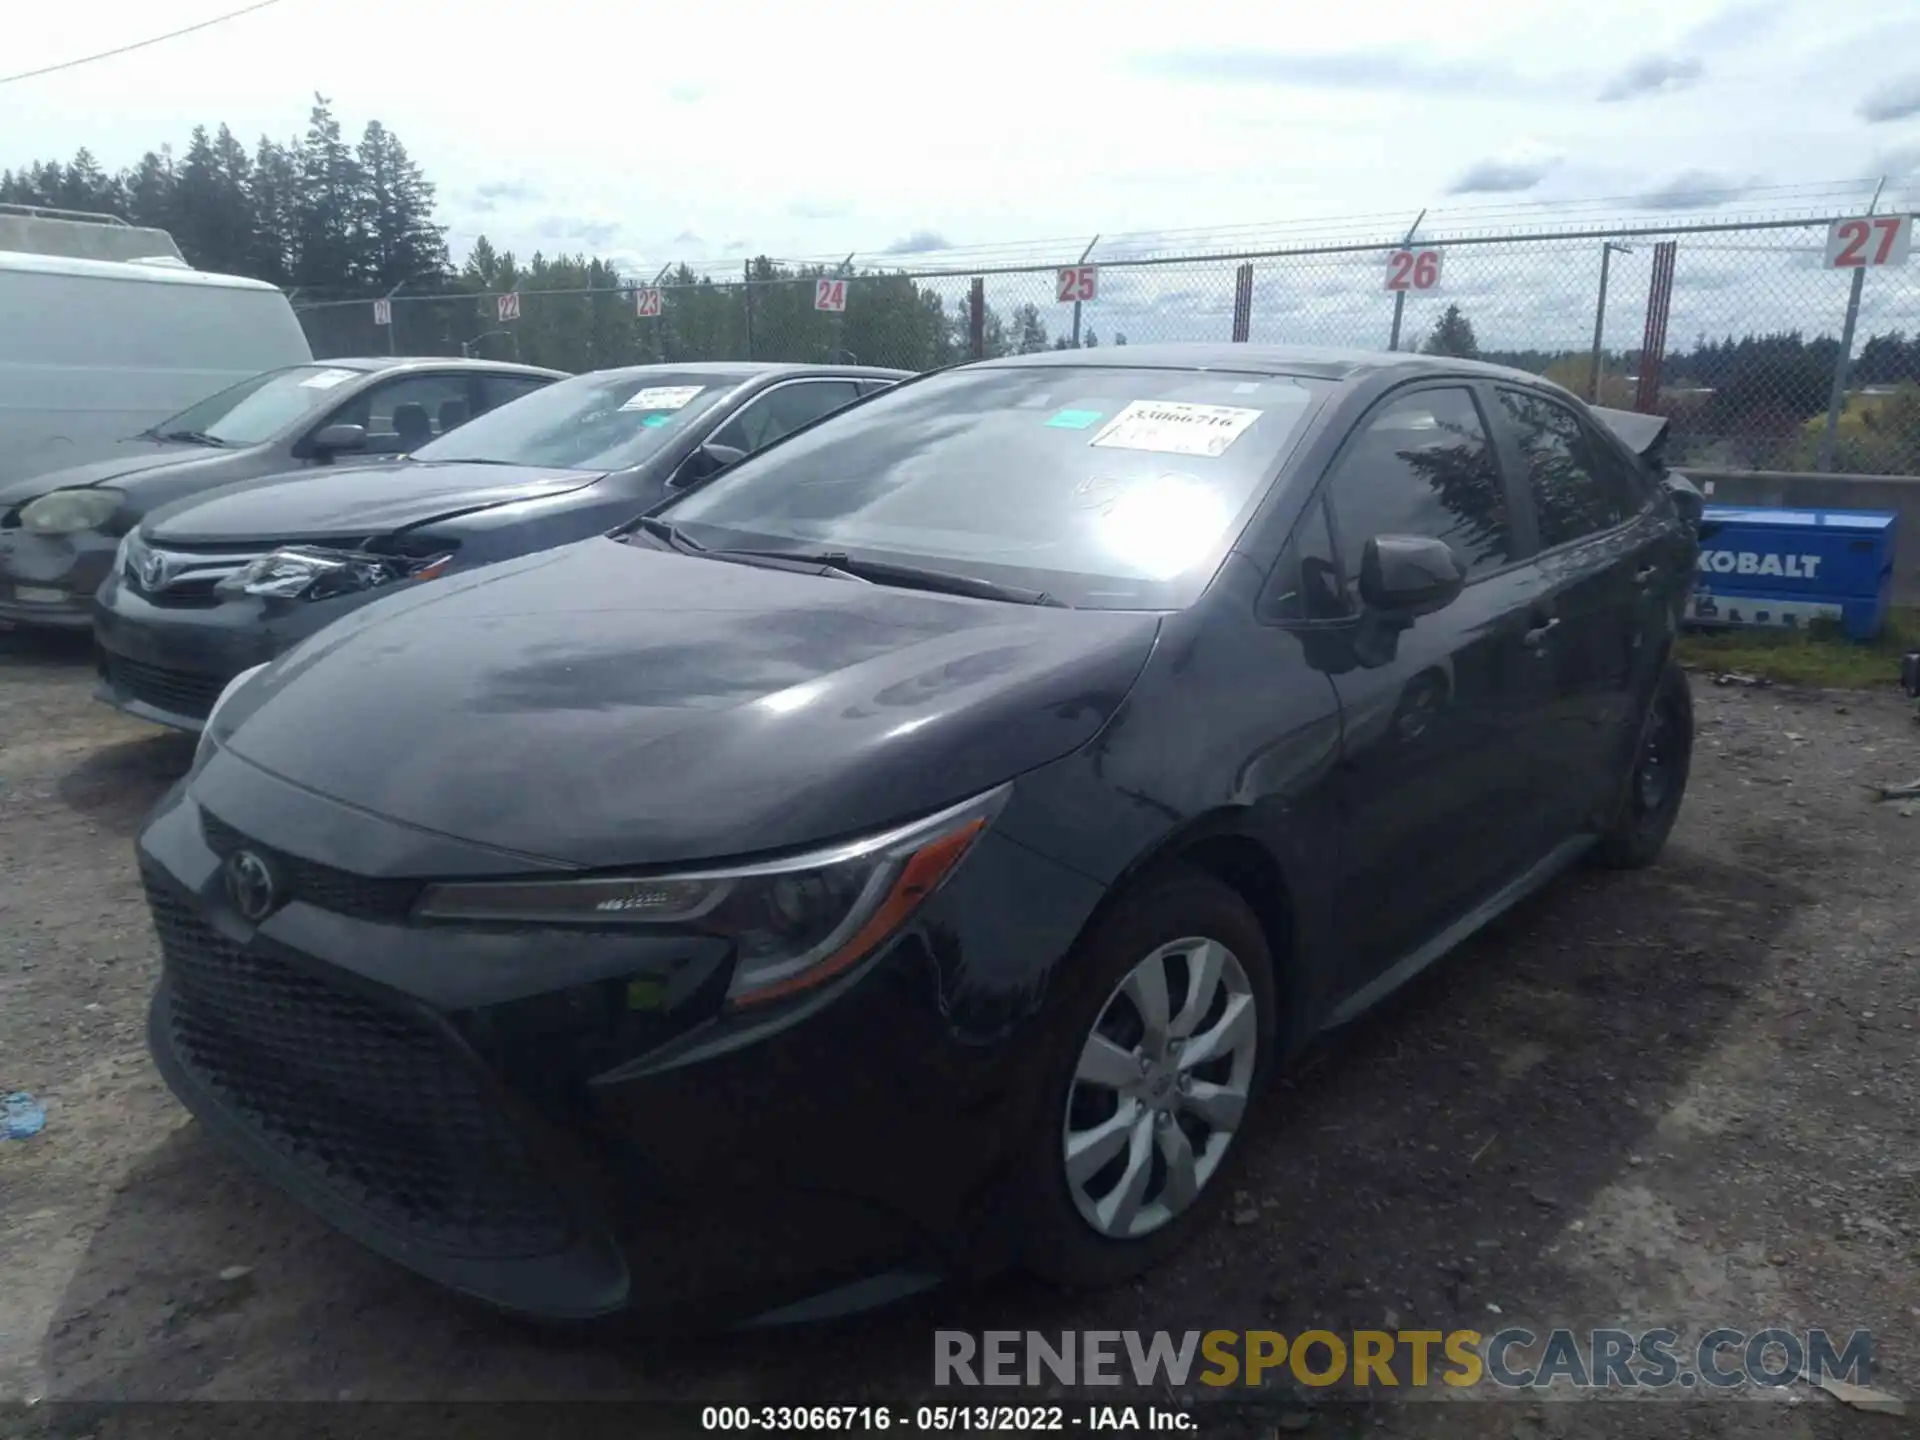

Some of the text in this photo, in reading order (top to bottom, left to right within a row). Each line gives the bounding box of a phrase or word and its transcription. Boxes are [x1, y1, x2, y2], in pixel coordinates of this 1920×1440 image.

[1834, 219, 1899, 267] 27
[1059, 268, 1094, 300] 25
[1388, 251, 1436, 290] 26
[500, 294, 518, 317] 22
[638, 291, 660, 315] 23
[818, 281, 844, 309] 24
